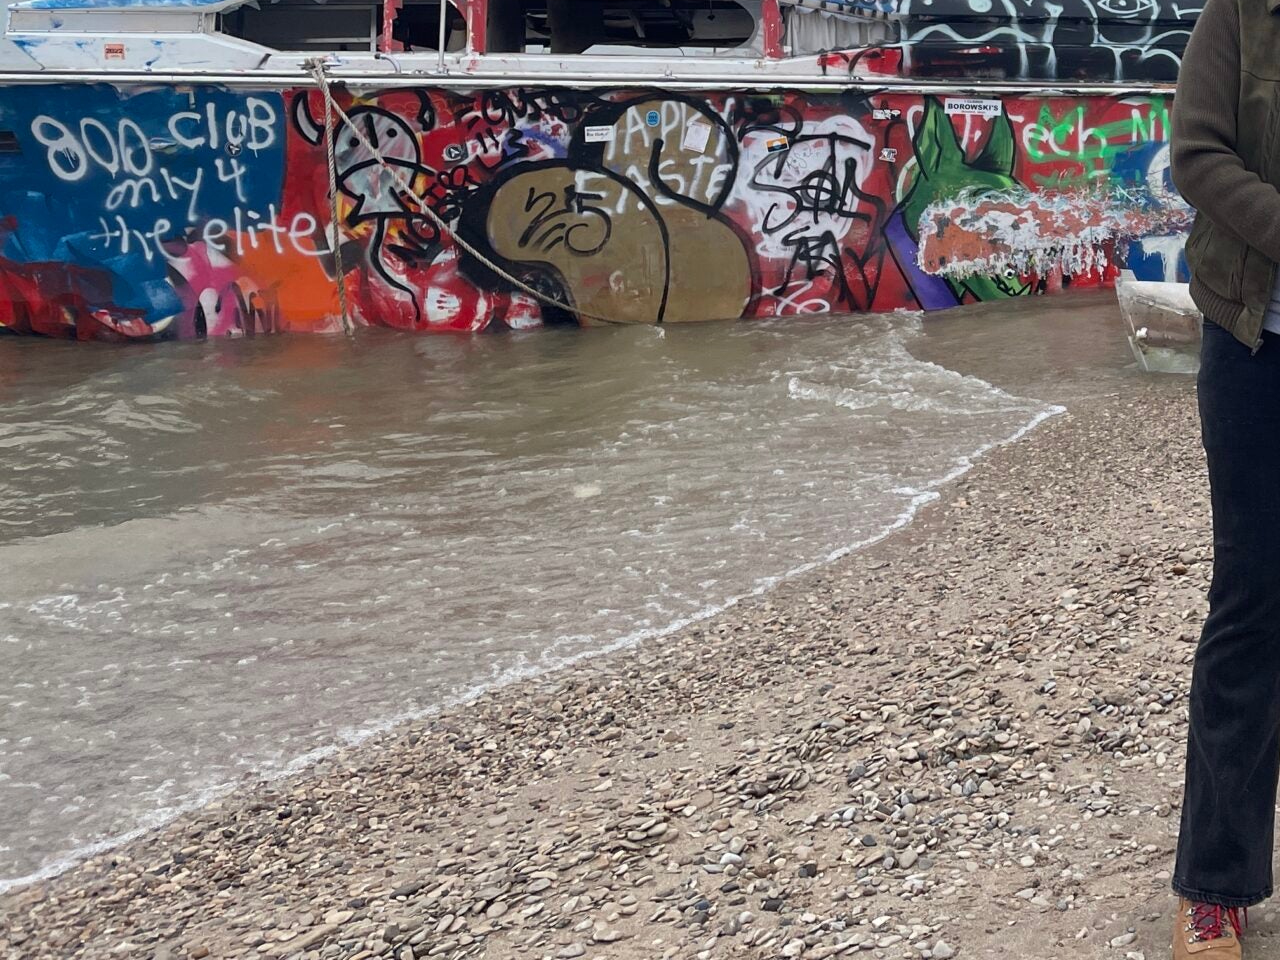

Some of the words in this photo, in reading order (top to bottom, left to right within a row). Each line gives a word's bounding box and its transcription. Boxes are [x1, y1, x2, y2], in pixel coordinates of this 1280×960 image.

[947, 103, 999, 111] BOROWSKI'S
[31, 114, 152, 181] 800
[106, 166, 203, 221] only
[215, 157, 248, 202] 4
[90, 215, 191, 261] the
[203, 203, 335, 256] elite
